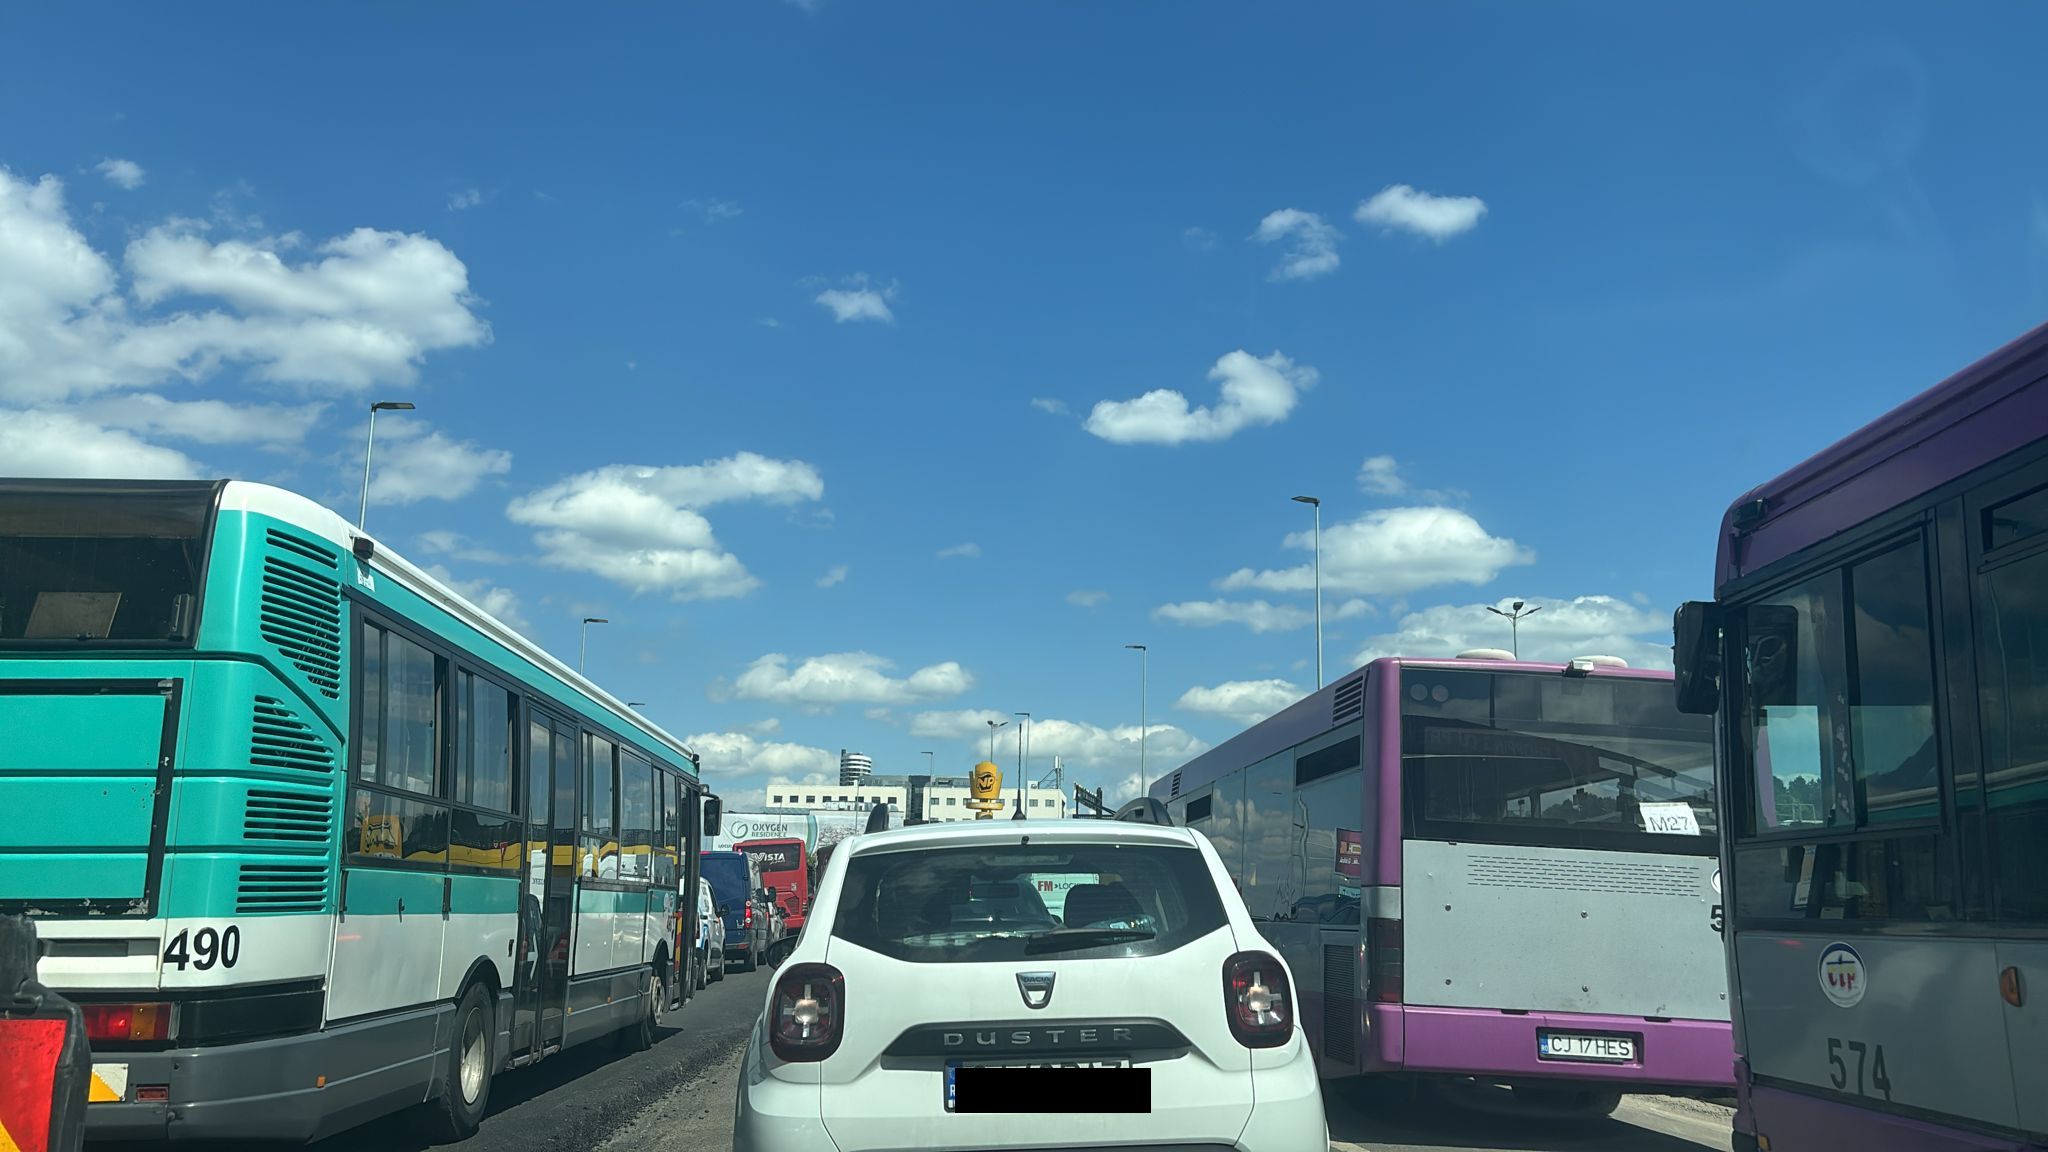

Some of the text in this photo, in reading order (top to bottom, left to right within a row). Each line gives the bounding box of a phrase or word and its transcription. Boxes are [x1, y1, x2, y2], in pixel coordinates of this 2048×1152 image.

[752, 823, 788, 832] OXYGEN
[1649, 816, 1688, 831] M27
[1037, 880, 1053, 891] FM
[163, 925, 241, 971] 490
[1023, 976, 1050, 984] DACIA
[943, 1027, 1133, 1046] DUSTER
[1827, 1037, 1892, 1101] 574
